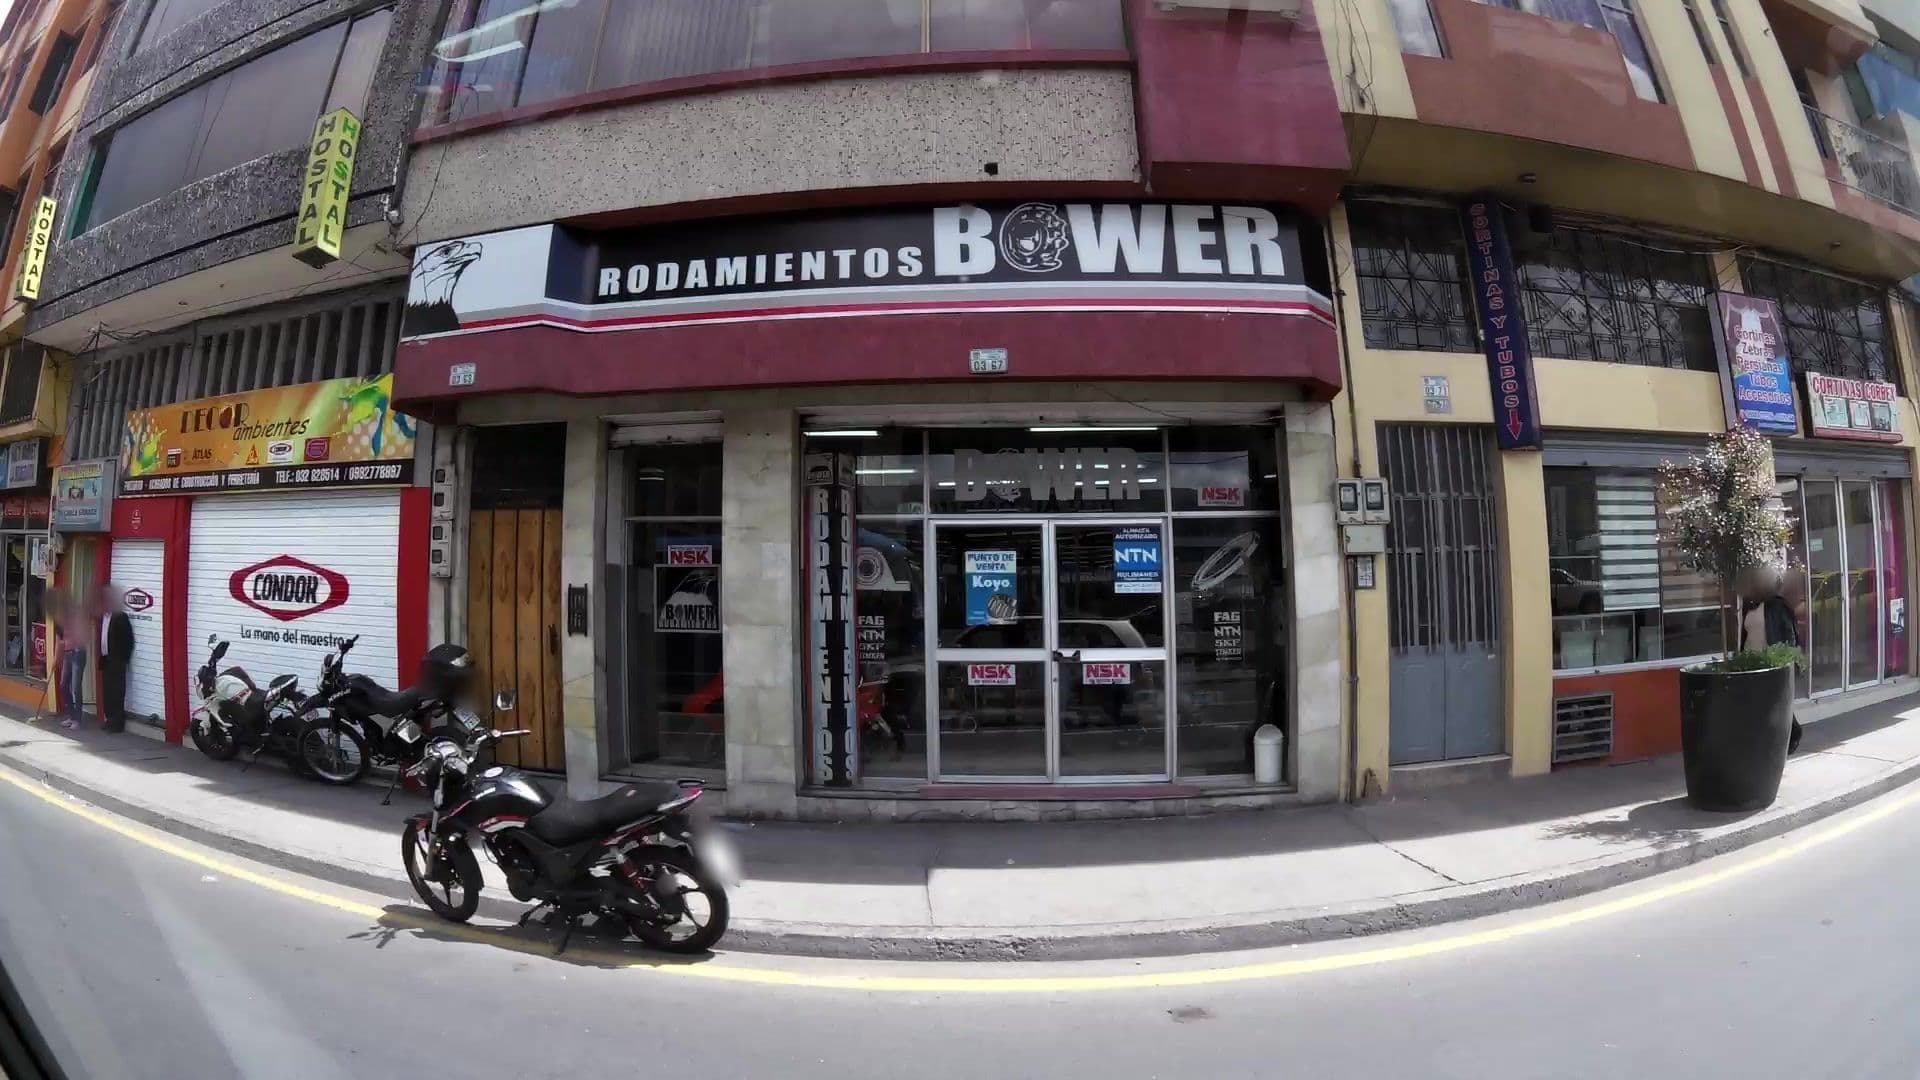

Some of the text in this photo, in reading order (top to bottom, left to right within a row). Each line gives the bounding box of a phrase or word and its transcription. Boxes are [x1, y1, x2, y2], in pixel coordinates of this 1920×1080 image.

[299, 117, 336, 245] HOSTAL
[323, 117, 357, 248] HOSTAL
[26, 202, 53, 293] HOSTAL
[599, 246, 923, 297] RODAMIENTOS
[1470, 203, 1520, 408] CORTINAS Y TUBOS
[1812, 376, 1861, 398] CORTINAS
[232, 416, 310, 441] ambientes
[1202, 488, 1240, 500] NSK
[671, 551, 710, 564] NSK
[1002, 553, 1015, 562] DE
[1114, 548, 1157, 563] NTN
[253, 573, 319, 604] CONDOR
[972, 575, 1010, 592] Koyo
[859, 616, 885, 625] FAG
[1214, 611, 1241, 621] FAG
[241, 624, 344, 648] La mano del maestro
[859, 630, 885, 641] NTN
[1214, 626, 1241, 637] NTN
[970, 665, 1012, 679] NSK
[1086, 664, 1126, 678] NSK
